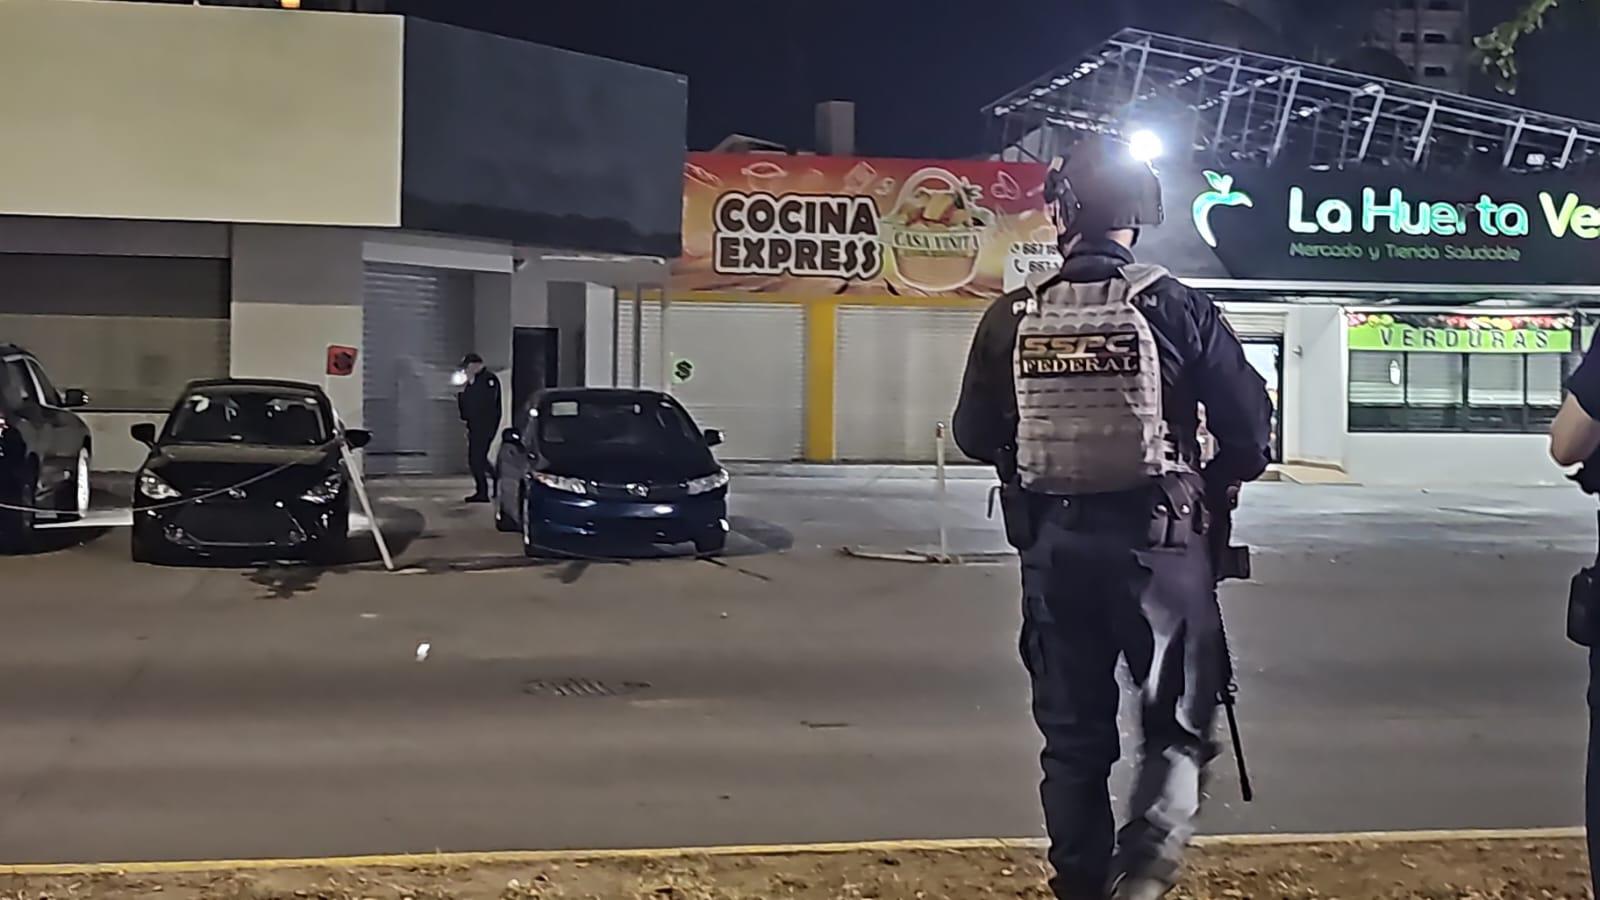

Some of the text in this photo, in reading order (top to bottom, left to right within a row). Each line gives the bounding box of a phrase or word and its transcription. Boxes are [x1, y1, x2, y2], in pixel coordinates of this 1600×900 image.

[719, 197, 878, 235] COCINA
[1288, 186, 1600, 239] La Huerta Ve
[719, 236, 878, 274] EXPRESS
[1289, 242, 1521, 261] Mercado y Tienda Saludable
[1023, 334, 1136, 354] SSPC
[1379, 328, 1549, 349] VERDURAS
[1022, 356, 1138, 374] FEDERAL
